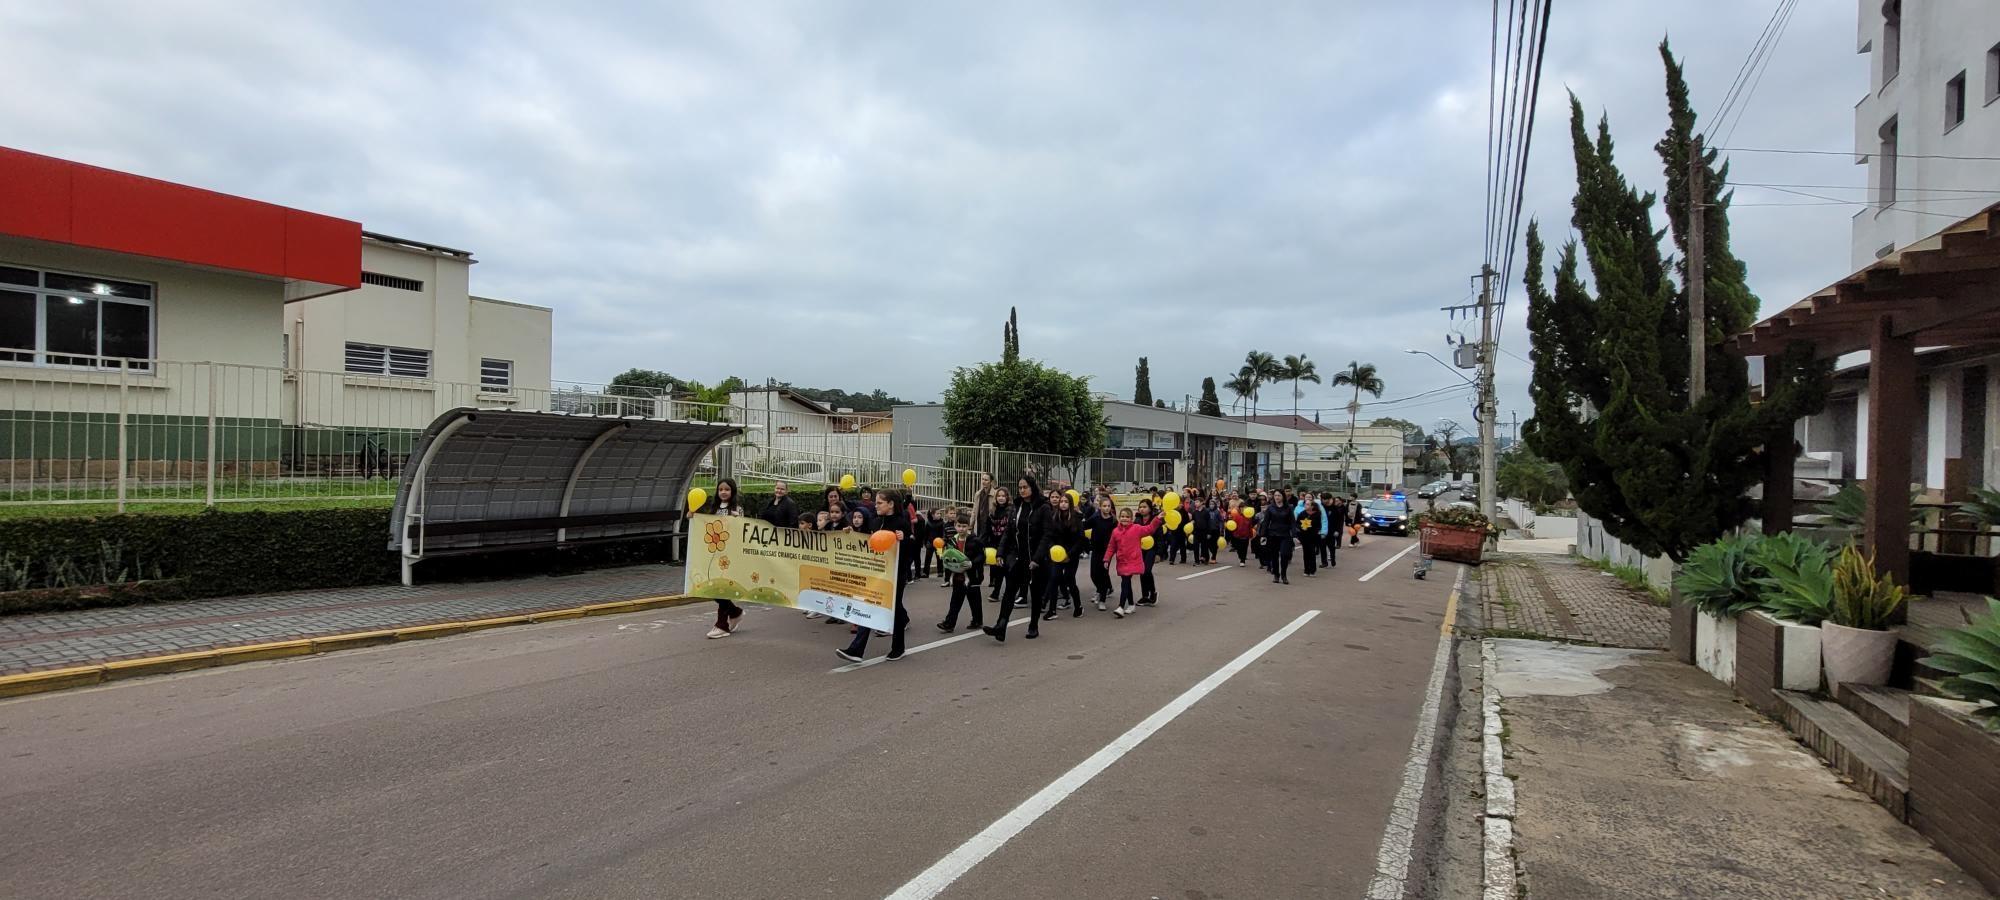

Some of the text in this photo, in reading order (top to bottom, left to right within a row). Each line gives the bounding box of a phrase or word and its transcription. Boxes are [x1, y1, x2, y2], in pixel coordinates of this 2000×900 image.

[742, 522, 828, 552] FAÇA BONITO
[846, 542, 856, 551] de
[760, 549, 777, 557] NOSSAS
[778, 551, 798, 560] CRIANÇAS
